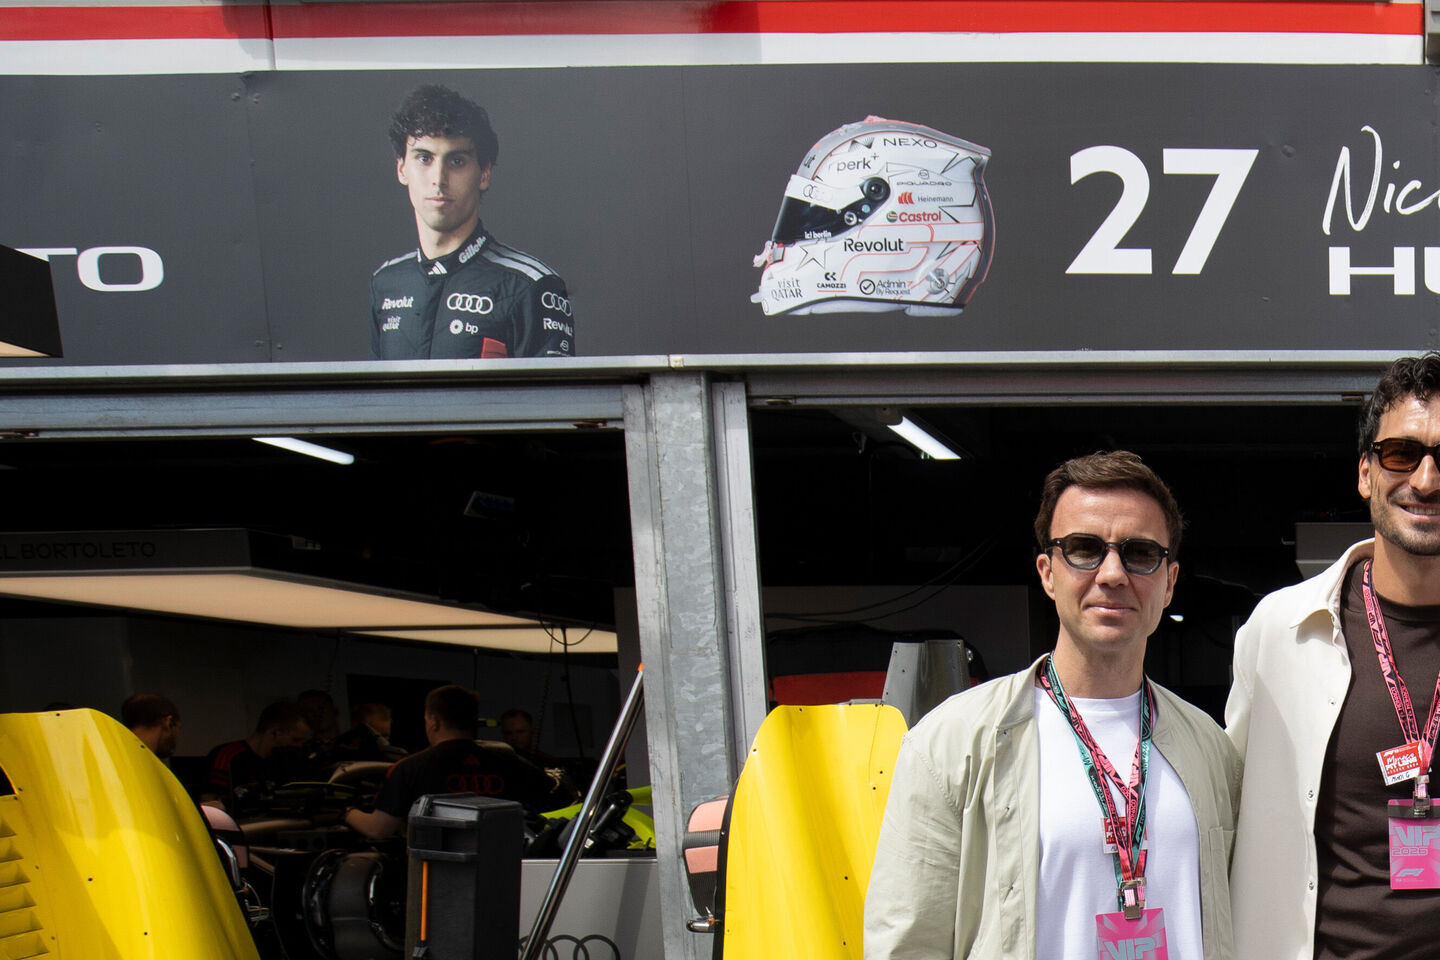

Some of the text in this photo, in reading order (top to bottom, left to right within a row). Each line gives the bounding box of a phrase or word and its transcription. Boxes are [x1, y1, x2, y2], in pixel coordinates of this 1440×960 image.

[883, 137, 938, 149] NEXO
[1065, 145, 1260, 275] 27
[899, 211, 942, 223] Castrol
[844, 238, 904, 252] Revolut
[777, 279, 801, 289] visit
[816, 282, 847, 290] CAMOZZI
[876, 279, 906, 289] Admin
[770, 288, 804, 299] QATAR
[382, 296, 415, 310] Revolut
[464, 321, 479, 335] bp
[21, 541, 156, 559] BORTOLETO
[1391, 847, 1429, 857] 2026
